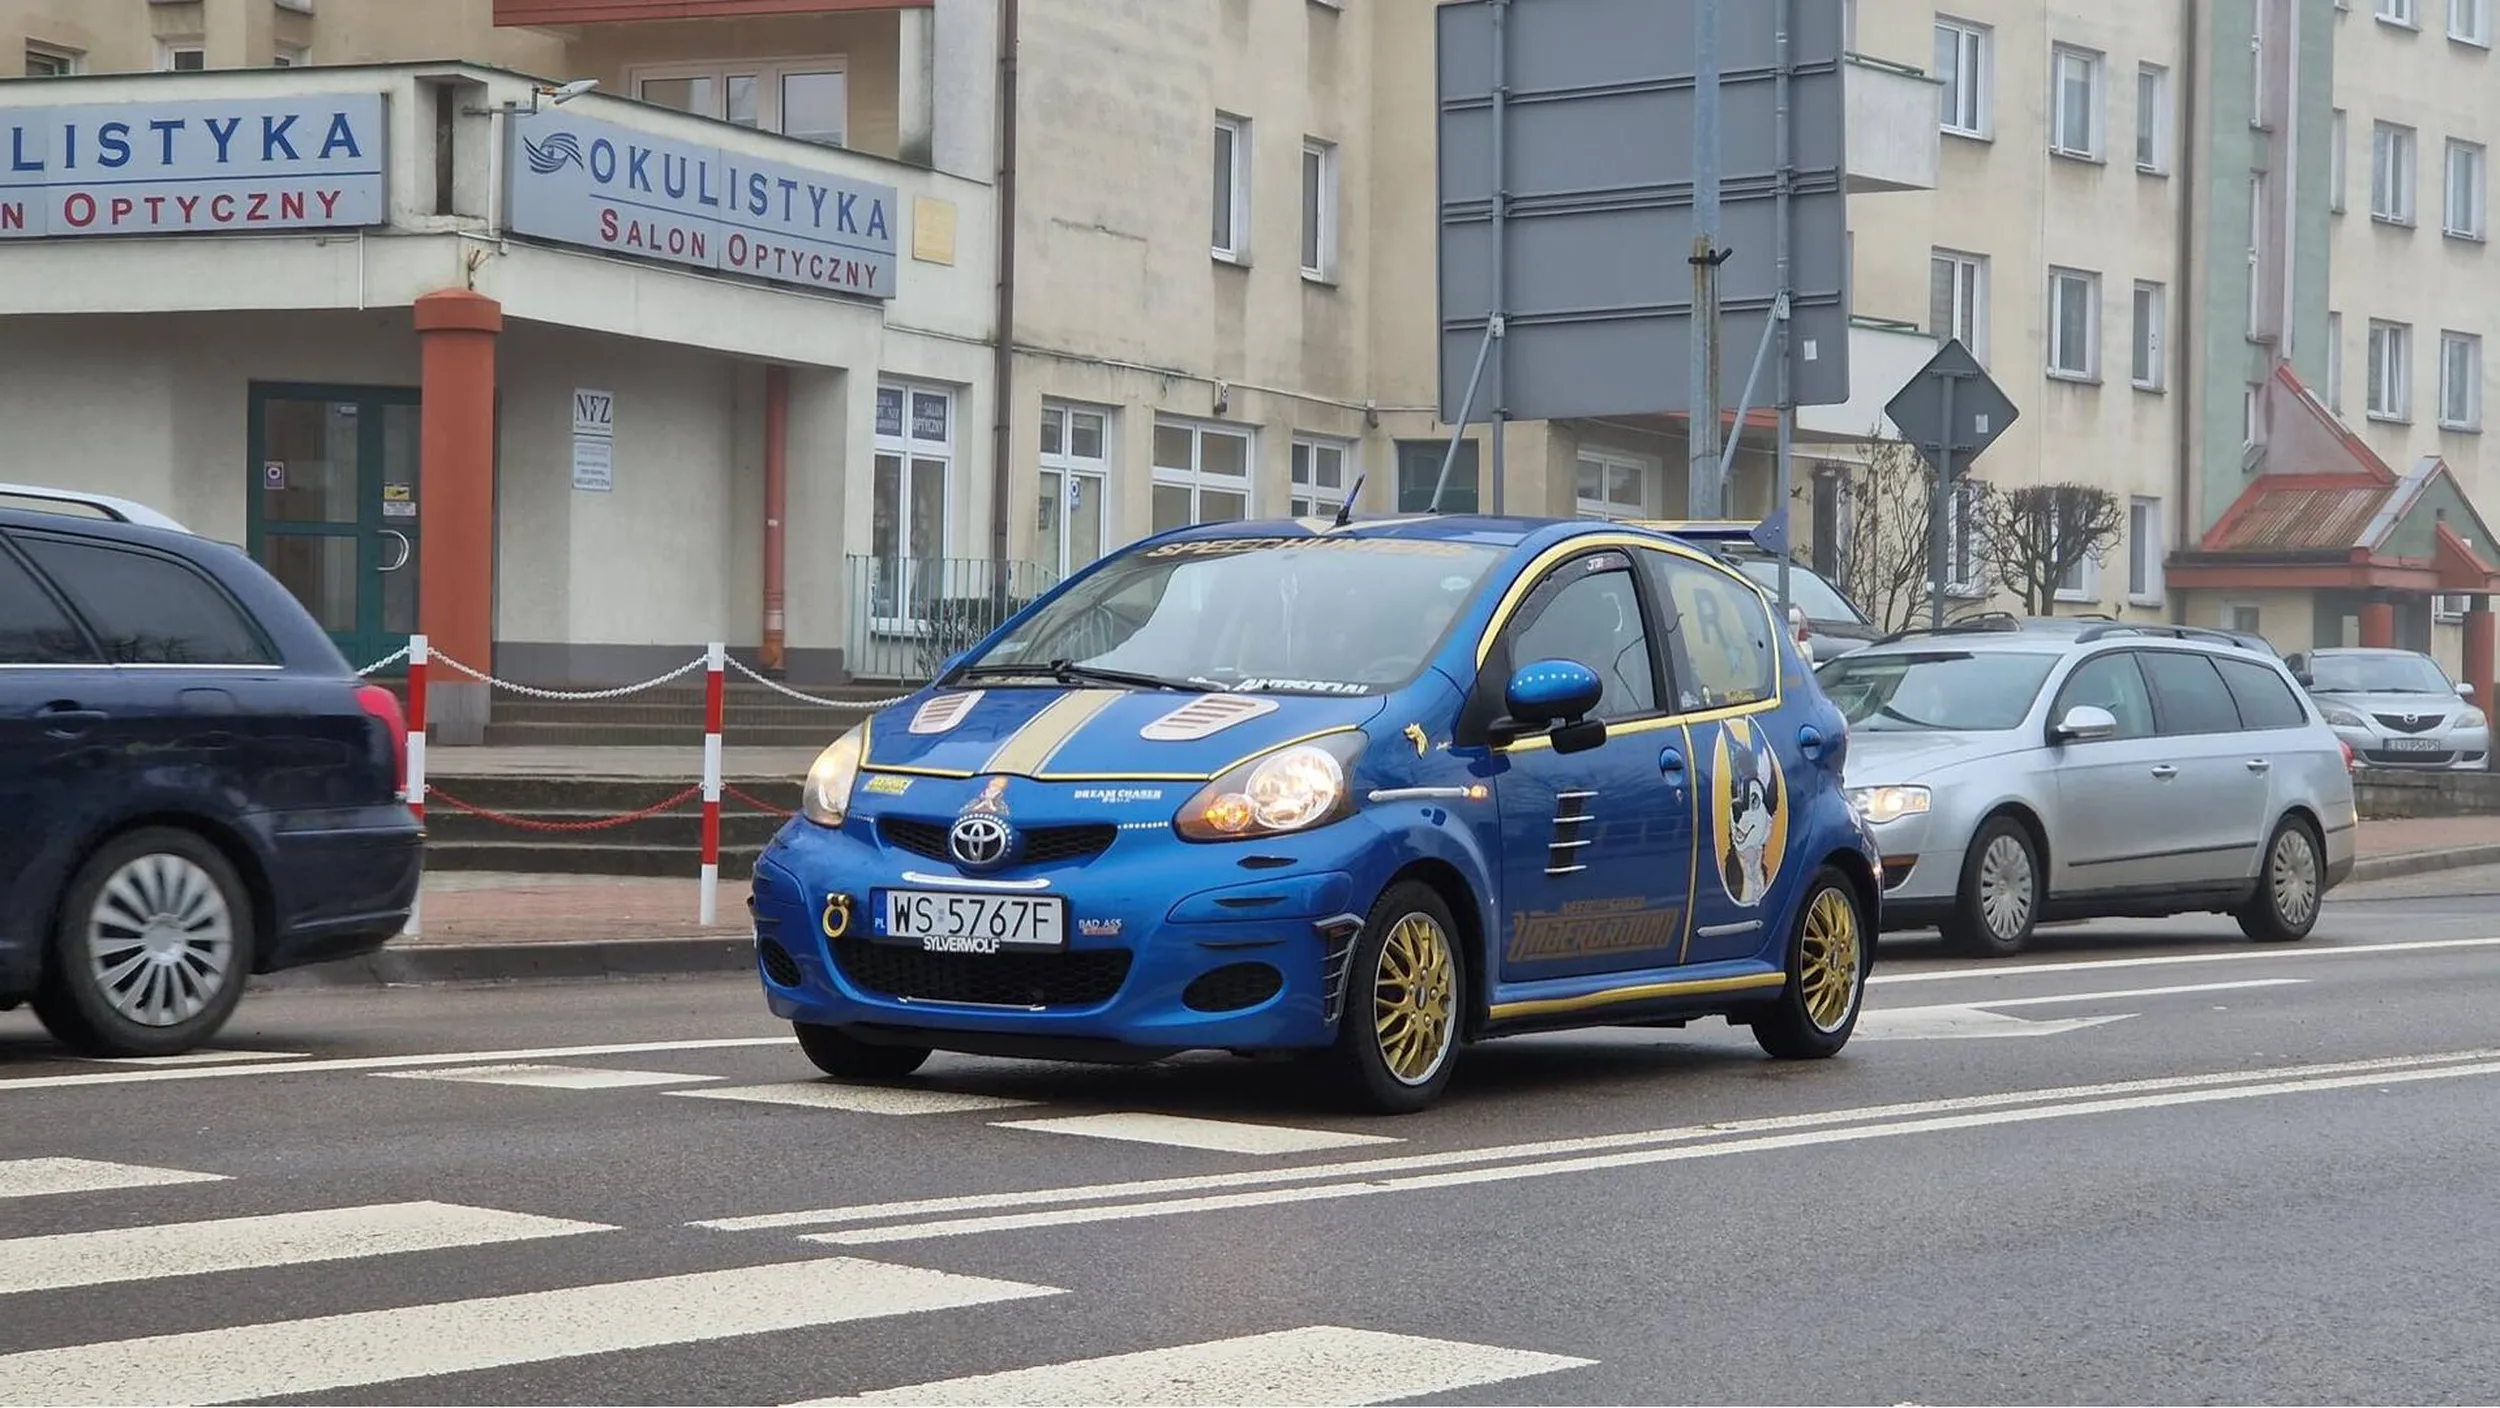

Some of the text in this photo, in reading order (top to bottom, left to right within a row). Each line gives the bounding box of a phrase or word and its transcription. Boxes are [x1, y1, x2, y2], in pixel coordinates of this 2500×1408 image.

[12, 112, 362, 172] LISTYKA
[64, 189, 342, 228] OPTYCZNY
[589, 138, 888, 241] OKULISTYKA
[600, 207, 878, 290] SALON OPTYCZNY
[576, 394, 611, 424] NFZ
[874, 917, 885, 928] PL
[894, 896, 1053, 940] WS 5767F
[923, 935, 1000, 954] SYLVERWOLF
